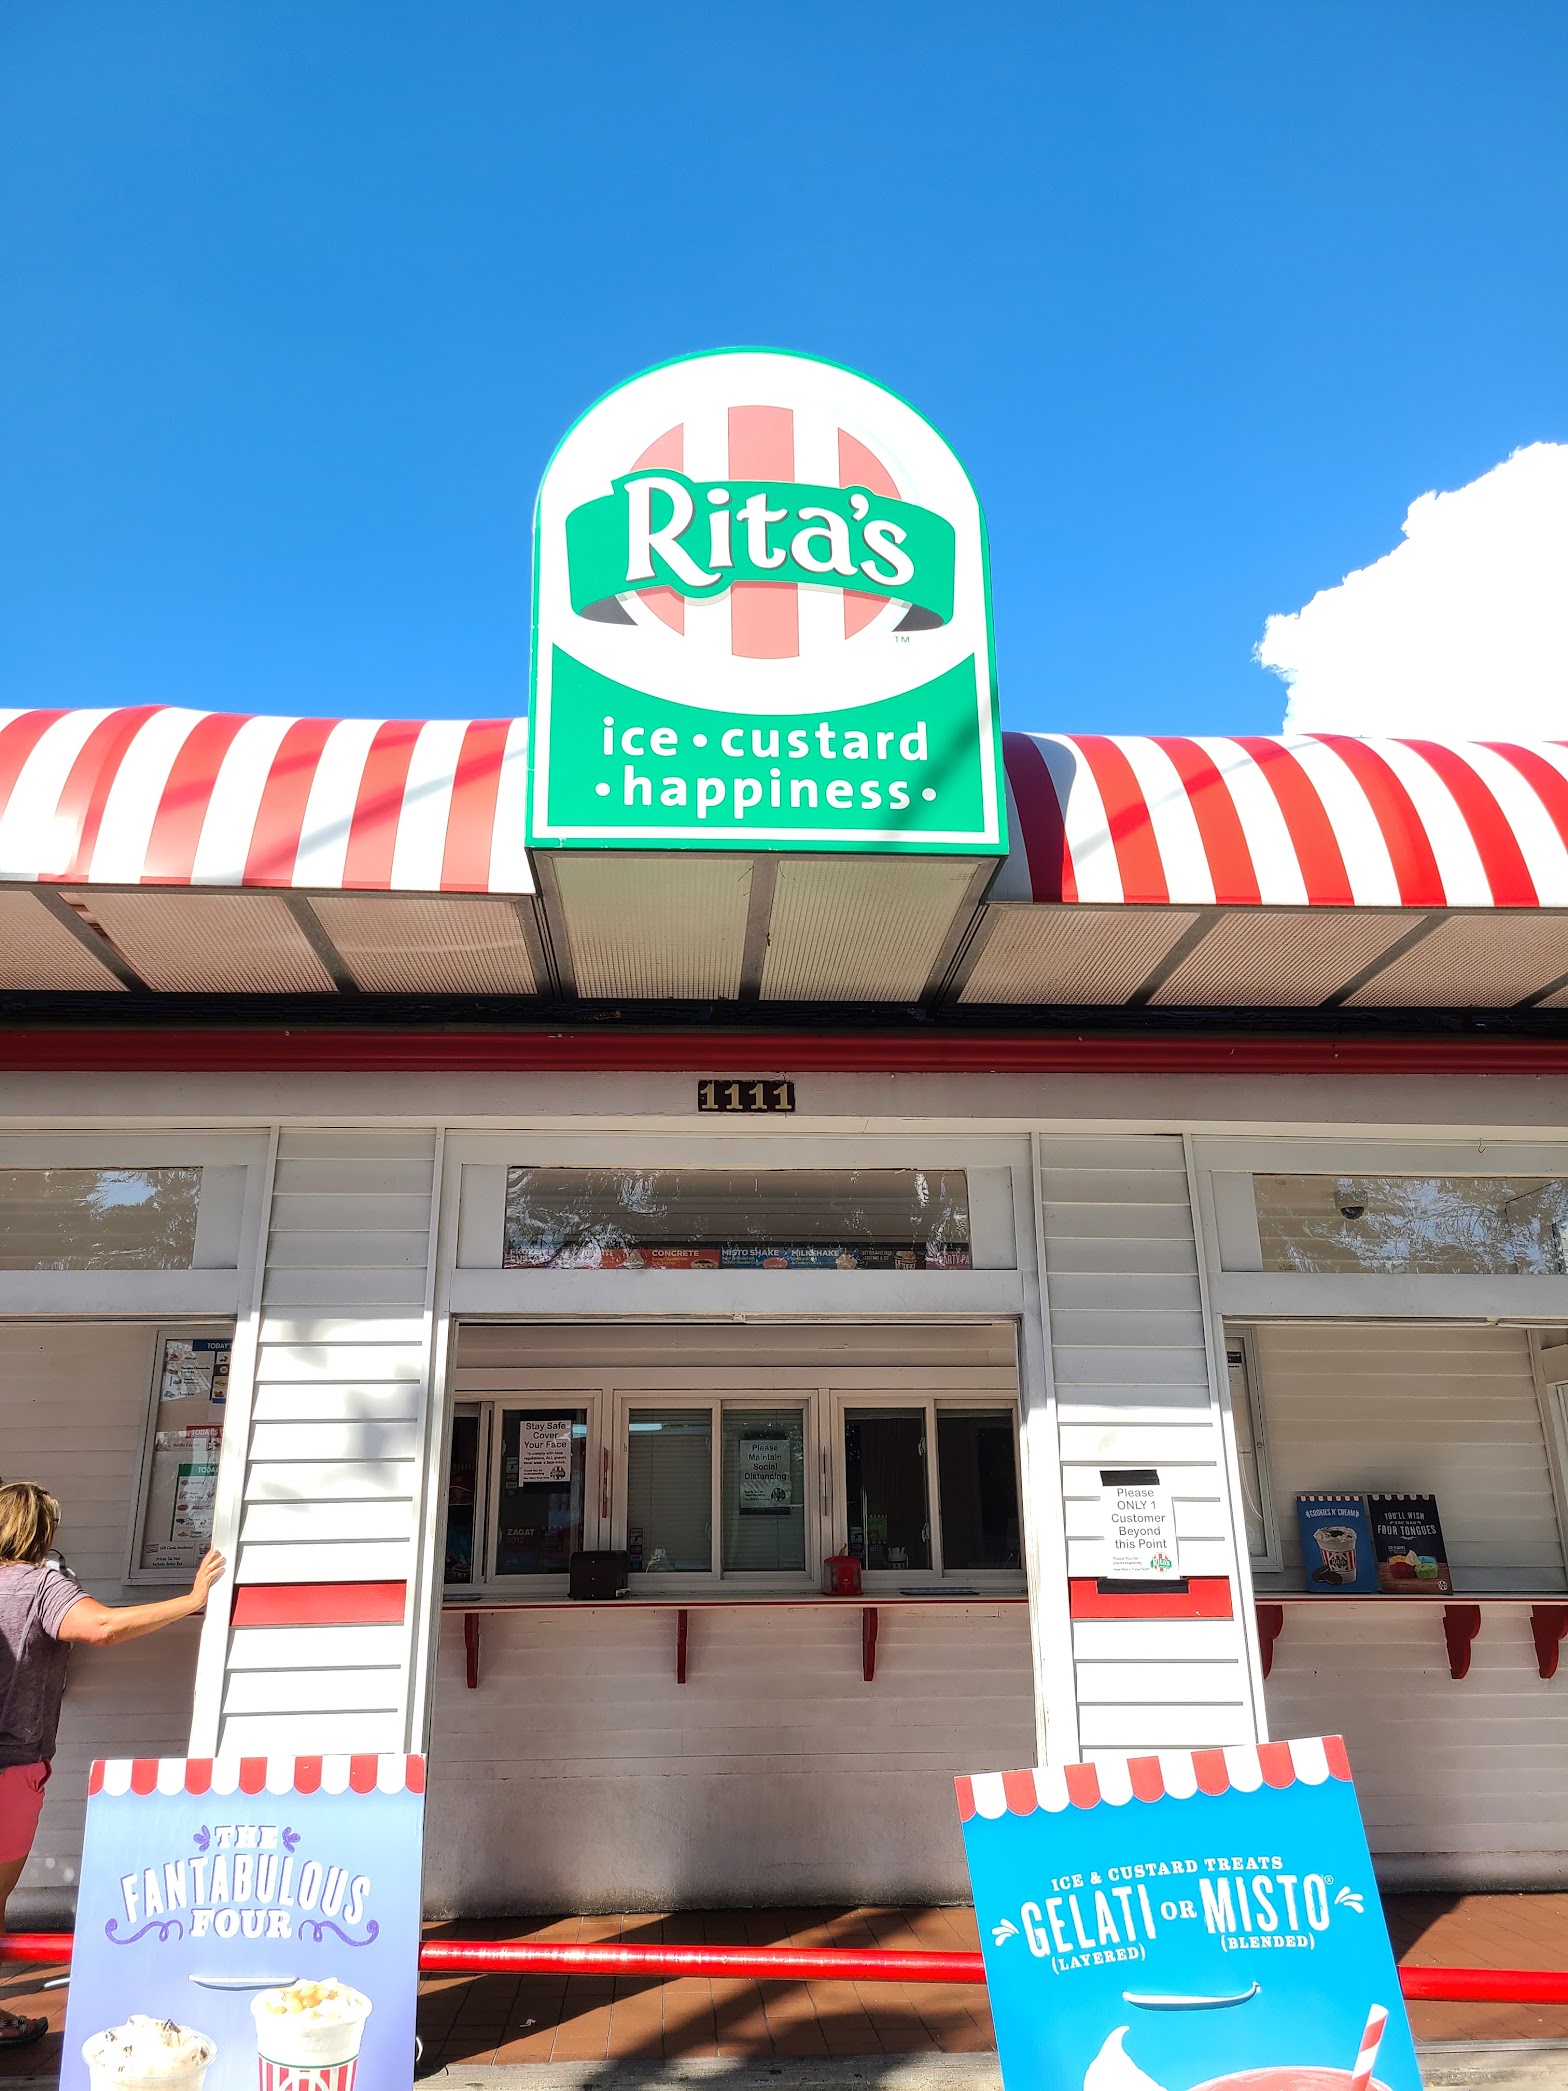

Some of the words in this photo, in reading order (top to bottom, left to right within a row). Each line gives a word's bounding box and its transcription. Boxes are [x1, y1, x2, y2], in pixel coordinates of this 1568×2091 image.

[623, 476, 915, 587] Rita's
[603, 716, 678, 756] ice
[721, 721, 928, 760] custard
[623, 765, 910, 819] happiness
[700, 1082, 792, 1109] 1111
[651, 1249, 700, 1258] CONCRETE
[750, 1248, 780, 1257] SHAKE
[526, 1422, 544, 1431] Stay
[547, 1422, 566, 1430] Safe
[524, 1441, 543, 1449] Your
[546, 1441, 567, 1449] Face
[752, 1444, 779, 1452] Please
[748, 1453, 782, 1461] Maintain
[753, 1463, 778, 1471] Social
[1117, 1488, 1154, 1497] Please
[1117, 1500, 1147, 1510] ONLY
[1150, 1500, 1156, 1510] 1
[1111, 1513, 1166, 1523] Customer
[1310, 1509, 1331, 1517] COOKIES
[1337, 1509, 1355, 1517] CREAM
[1384, 1512, 1405, 1520] YOU'LL
[1407, 1512, 1425, 1520] WISH
[1119, 1526, 1161, 1538] Beyond
[1377, 1524, 1398, 1536] FOUR
[1400, 1525, 1437, 1536] TONGUES
[1115, 1539, 1136, 1549] this
[1138, 1539, 1167, 1549] Point
[214, 1825, 278, 1849] THE
[1051, 1873, 1085, 1892] ICE
[1089, 1871, 1103, 1885] &
[1107, 1859, 1198, 1882] CUSTARD
[1204, 1855, 1283, 1872] TREATS
[120, 1853, 371, 1925] FANTABULOUS
[189, 1907, 293, 1939] FOUR
[1020, 1883, 1157, 1958] GELATI
[1160, 1900, 1197, 1920] OR
[1051, 1942, 1146, 1976] (LAYERED)
[1220, 1931, 1316, 1953] (BLENDED)
